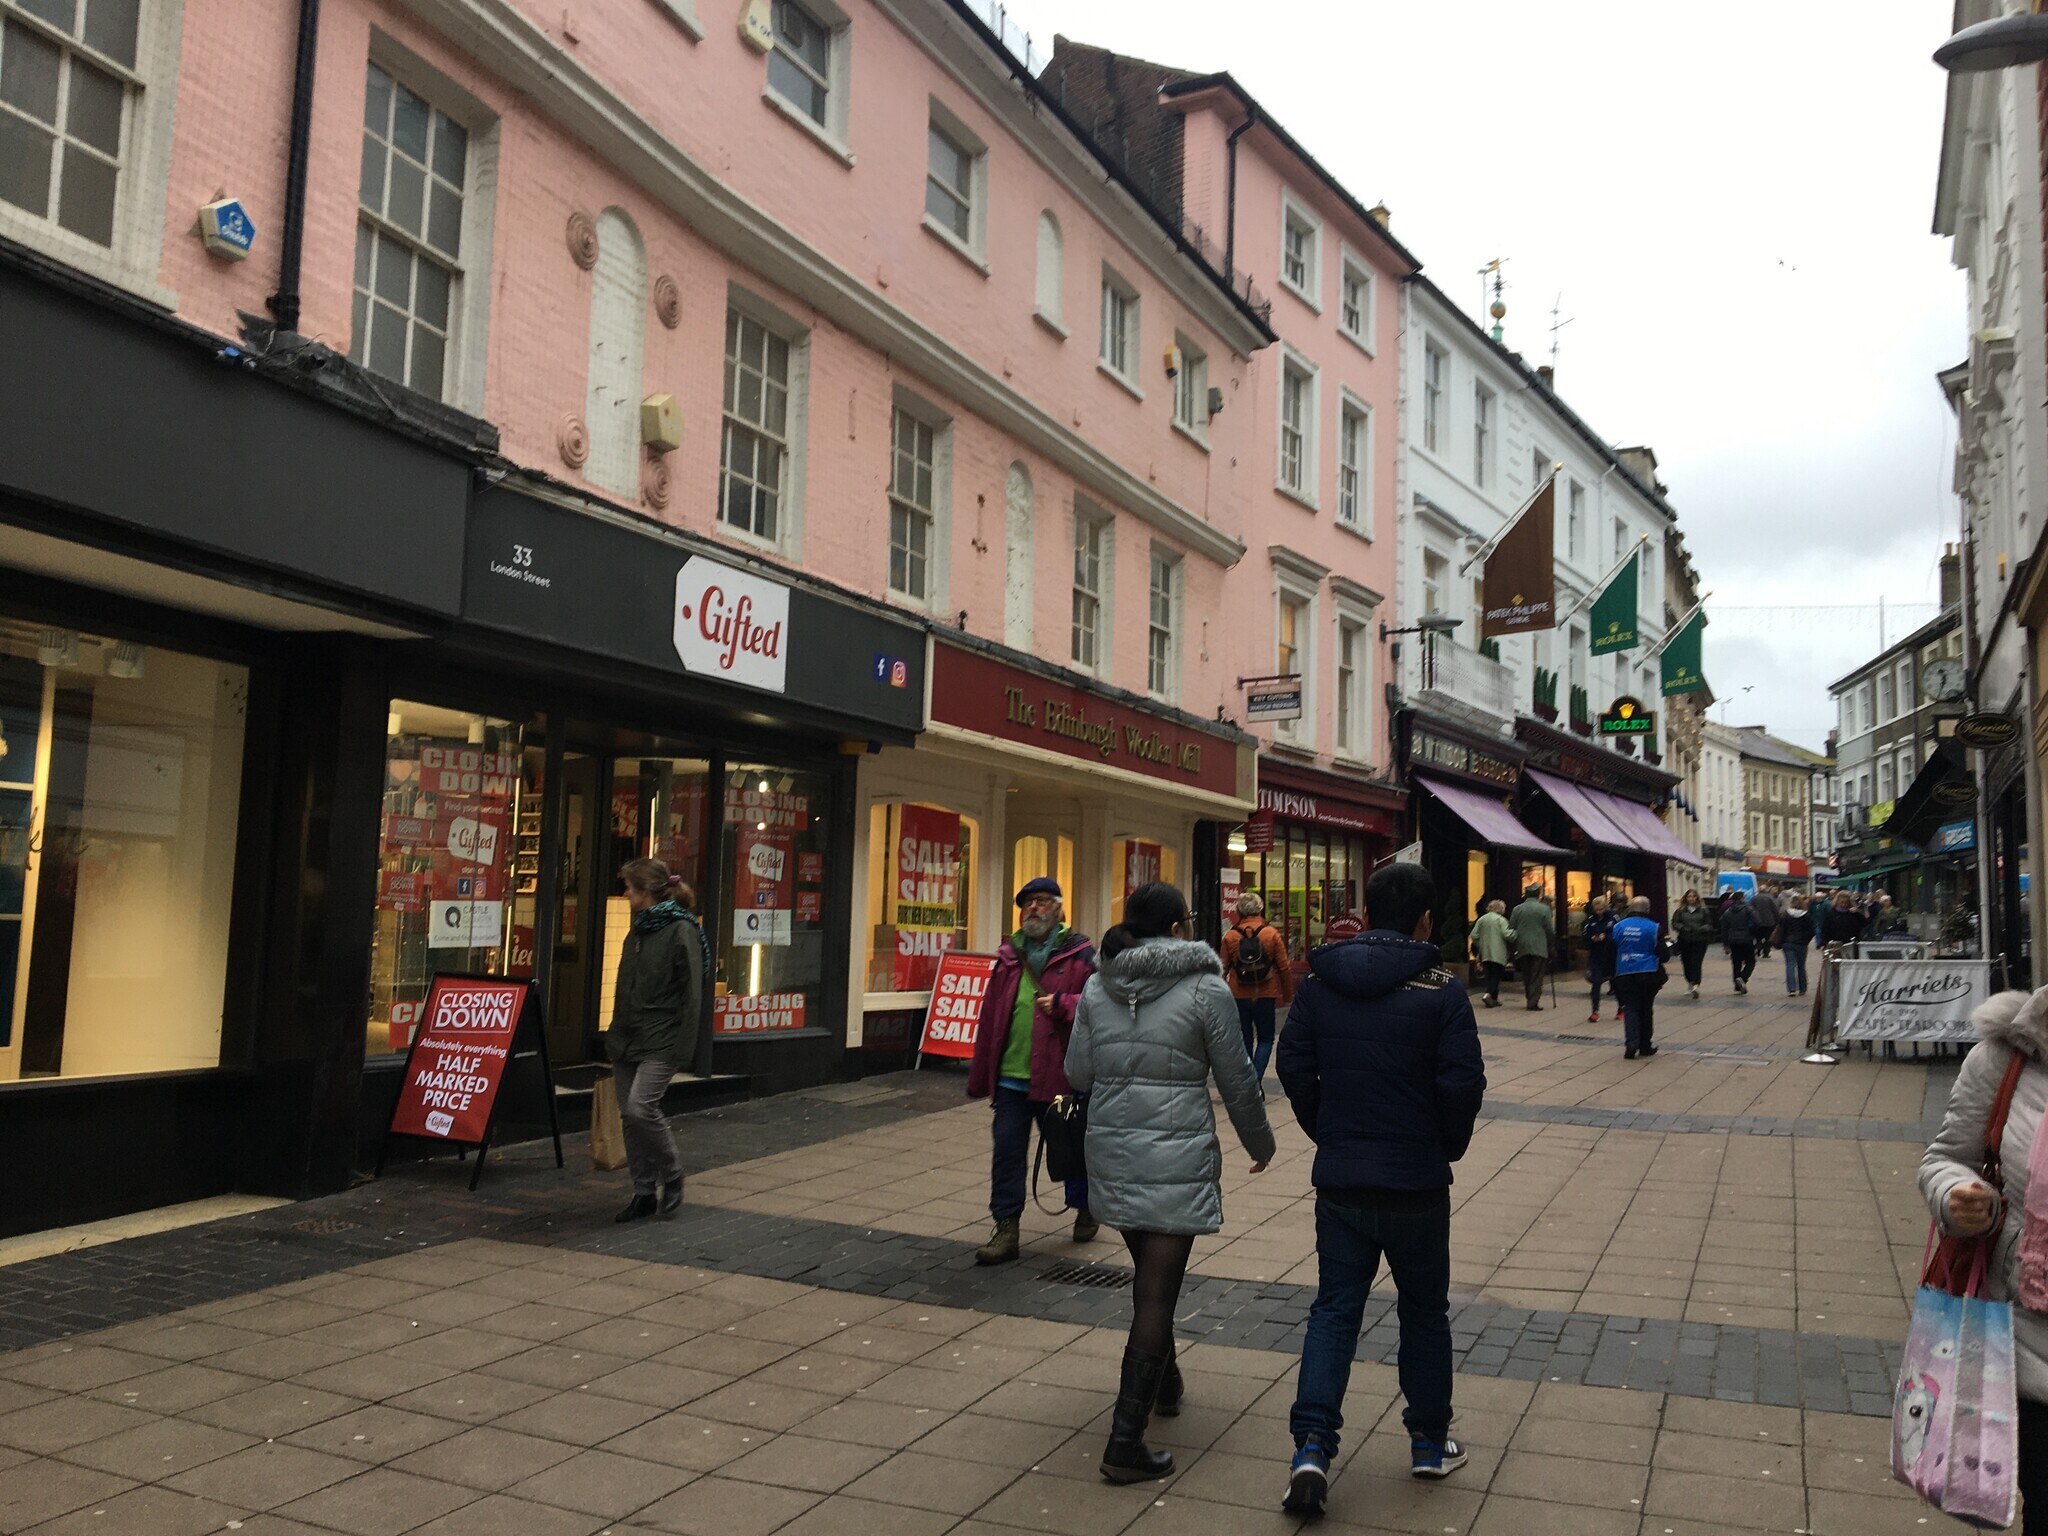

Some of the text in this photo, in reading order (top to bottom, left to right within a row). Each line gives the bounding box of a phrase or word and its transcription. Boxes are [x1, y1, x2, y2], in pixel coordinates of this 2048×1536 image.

[513, 544, 532, 567] 33
[490, 560, 551, 588] London Street
[1486, 609, 1514, 620] PATEK
[698, 585, 782, 670] Gifted
[1595, 631, 1633, 648] ROLEX
[1665, 675, 1698, 689] ROLEX
[1004, 684, 1200, 773] The Edinburgh Woollen Mill
[1603, 718, 1650, 731] ROLEX
[1259, 787, 1317, 819] TIMPSON
[726, 807, 796, 826] DOWN
[459, 827, 494, 855] Gifted
[901, 837, 955, 876] SALE
[440, 993, 513, 1009] CLOSING
[1854, 973, 1965, 1008] Harriets
[715, 993, 804, 1014] CLOSING
[935, 997, 983, 1020] SAL
[435, 1008, 510, 1028] DOWN
[724, 1011, 793, 1030] DOWN
[929, 1020, 979, 1043] SAL
[420, 1037, 507, 1059] Absolutely everything
[436, 1053, 482, 1074] HALF
[414, 1070, 489, 1094] MARKED
[421, 1089, 473, 1111] PRICE
[431, 1115, 451, 1131] Gifted
